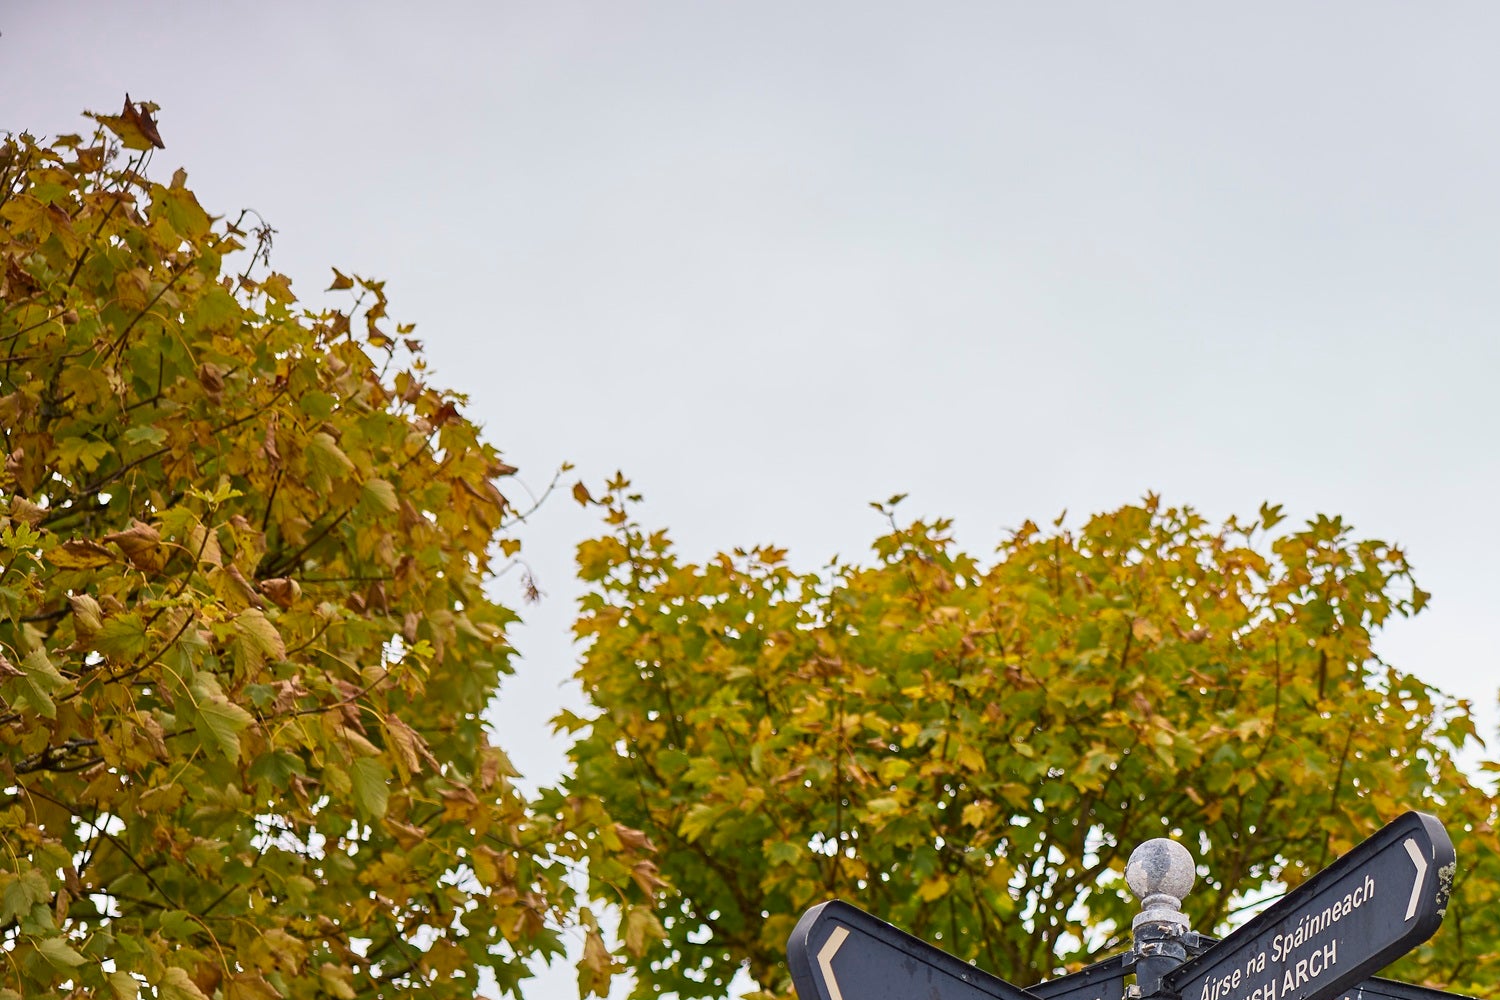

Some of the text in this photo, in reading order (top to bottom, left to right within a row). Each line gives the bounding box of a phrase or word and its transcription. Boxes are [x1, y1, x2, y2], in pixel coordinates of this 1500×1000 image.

[1247, 954, 1266, 978] na
[1272, 875, 1375, 960] Spáinneach
[1280, 940, 1337, 997] ARCH
